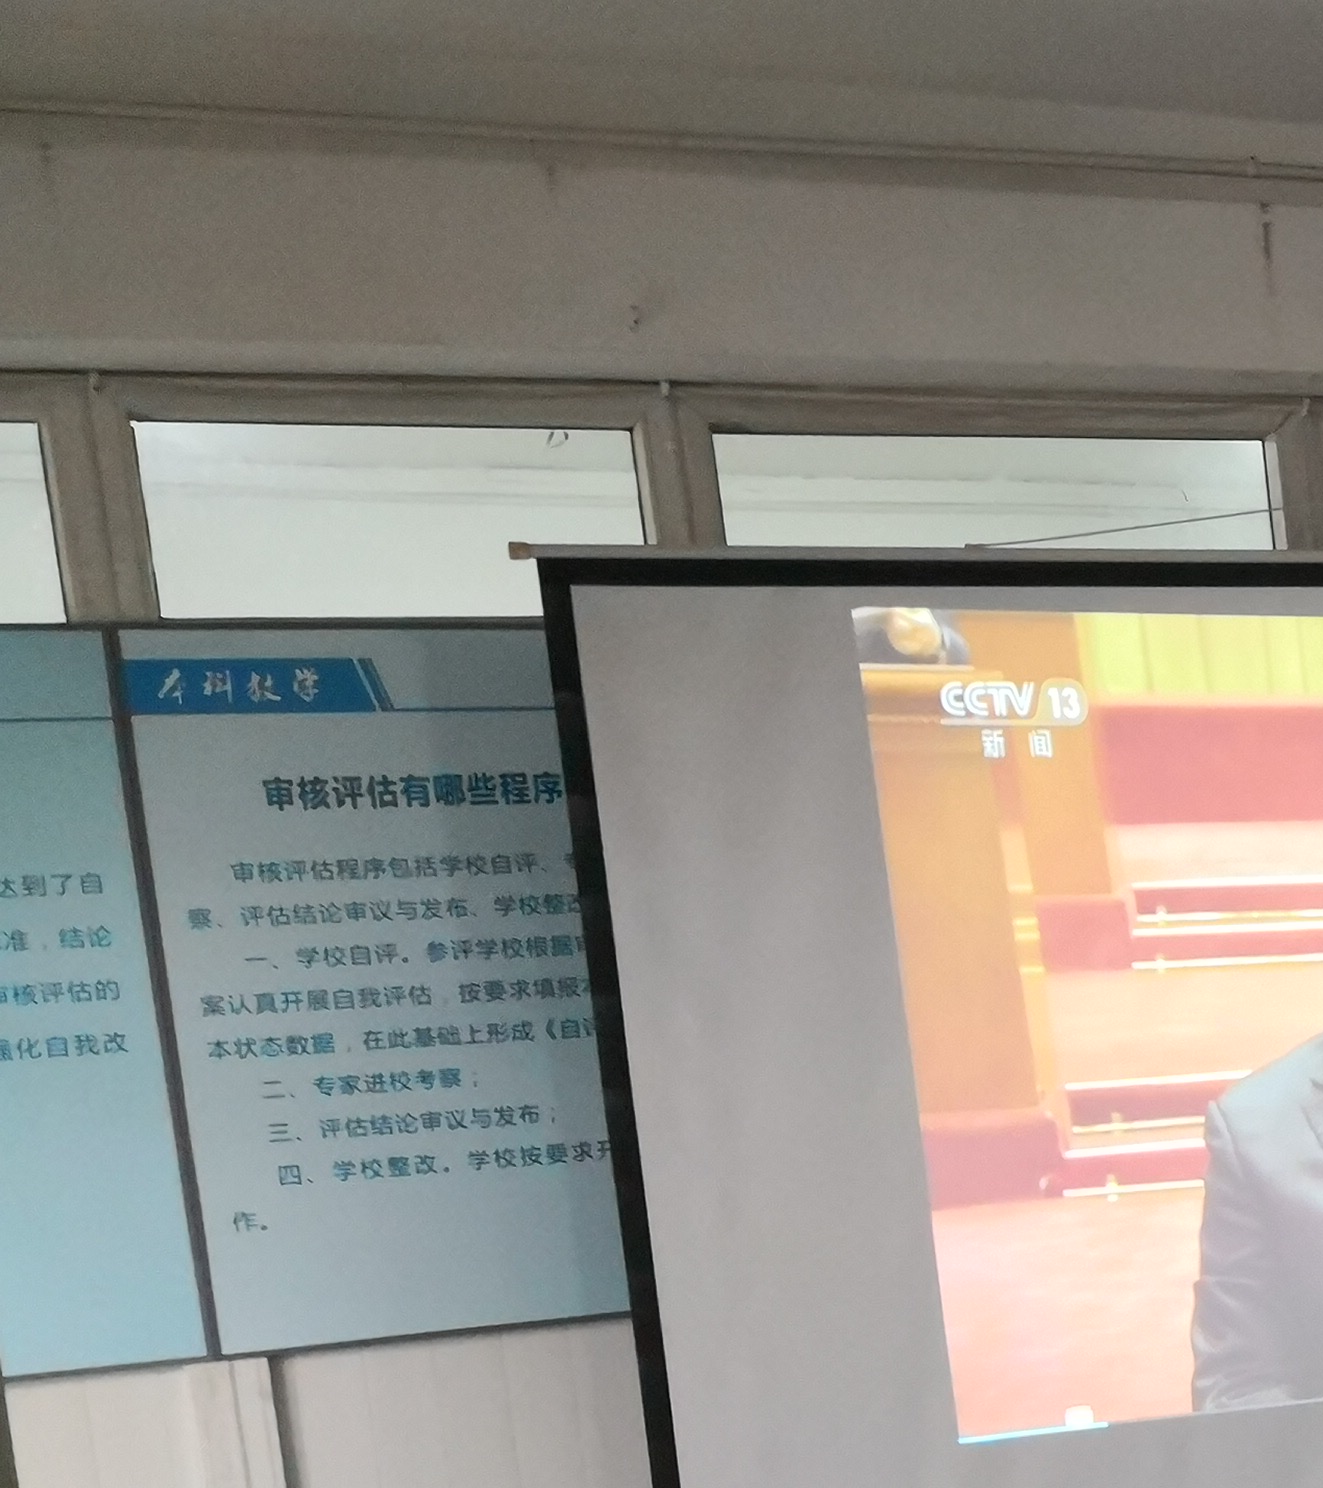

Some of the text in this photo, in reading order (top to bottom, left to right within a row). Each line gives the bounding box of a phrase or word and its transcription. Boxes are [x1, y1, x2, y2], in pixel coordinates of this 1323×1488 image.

[158, 668, 320, 705] 本科教学
[940, 681, 1081, 719] CCTV 13
[981, 729, 1053, 758] 新闻
[261, 772, 564, 812] 审核评估有哪些程序
